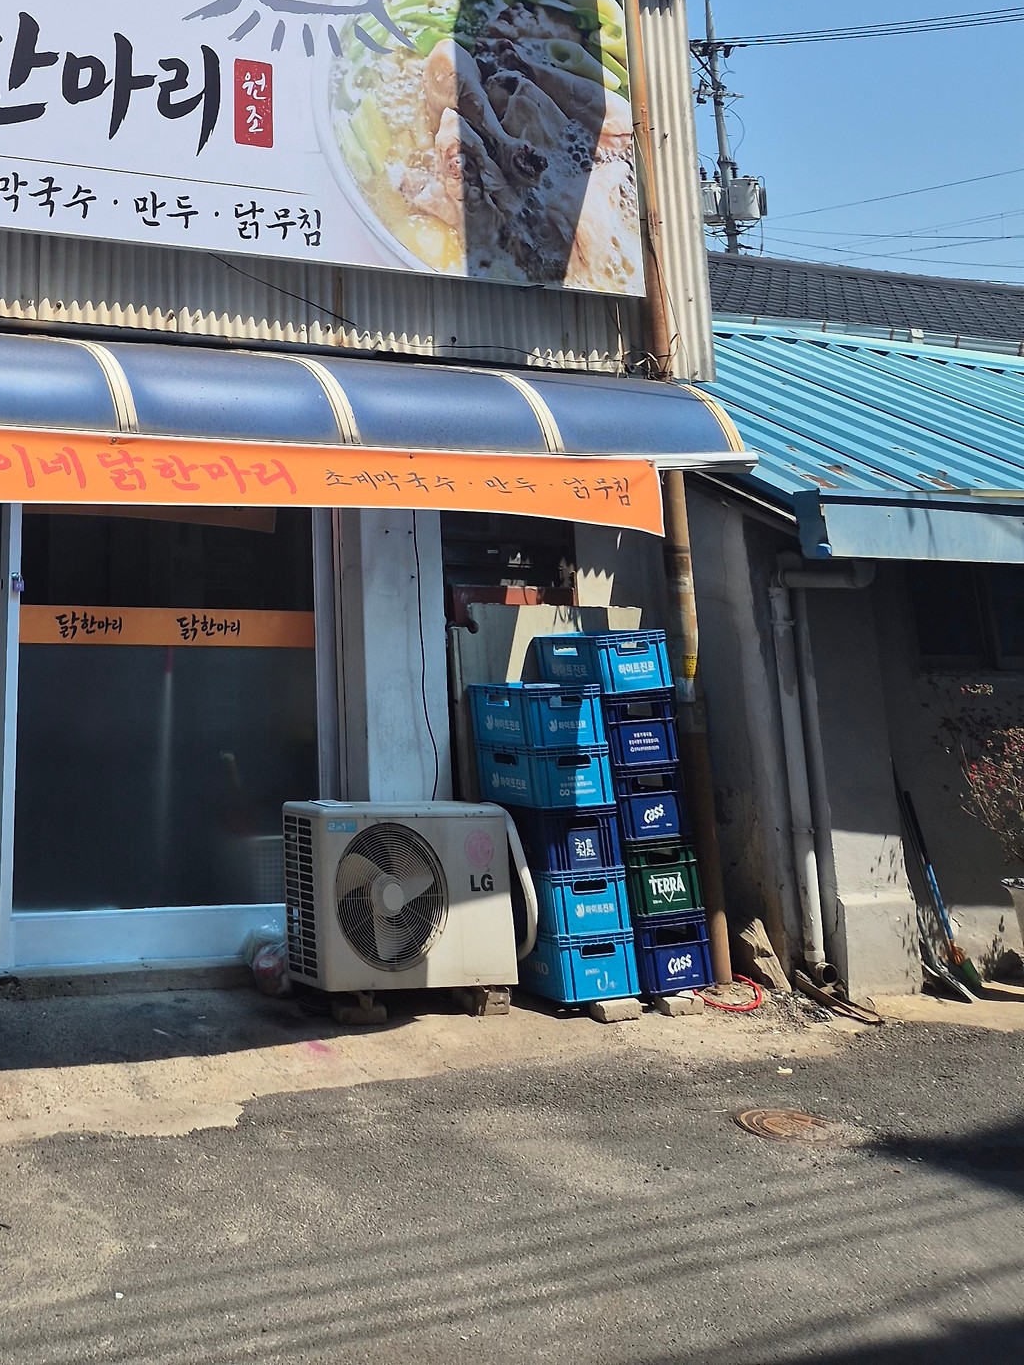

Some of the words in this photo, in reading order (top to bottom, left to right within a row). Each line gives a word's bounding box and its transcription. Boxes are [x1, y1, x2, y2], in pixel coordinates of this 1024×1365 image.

[241, 72, 268, 133] 원조
[133, 190, 199, 230] 만두
[232, 200, 322, 247] 닭무침
[97, 450, 298, 495] 닭한마리
[326, 469, 455, 493] 초계막국수
[484, 475, 537, 494] 만두
[563, 477, 631, 507] 닭무침
[55, 611, 123, 639] 닭한마리
[176, 614, 241, 641] 닭한마리
[618, 660, 656, 675] 하이트진로
[470, 874, 494, 892] LG
[648, 875, 686, 895] TERRA
